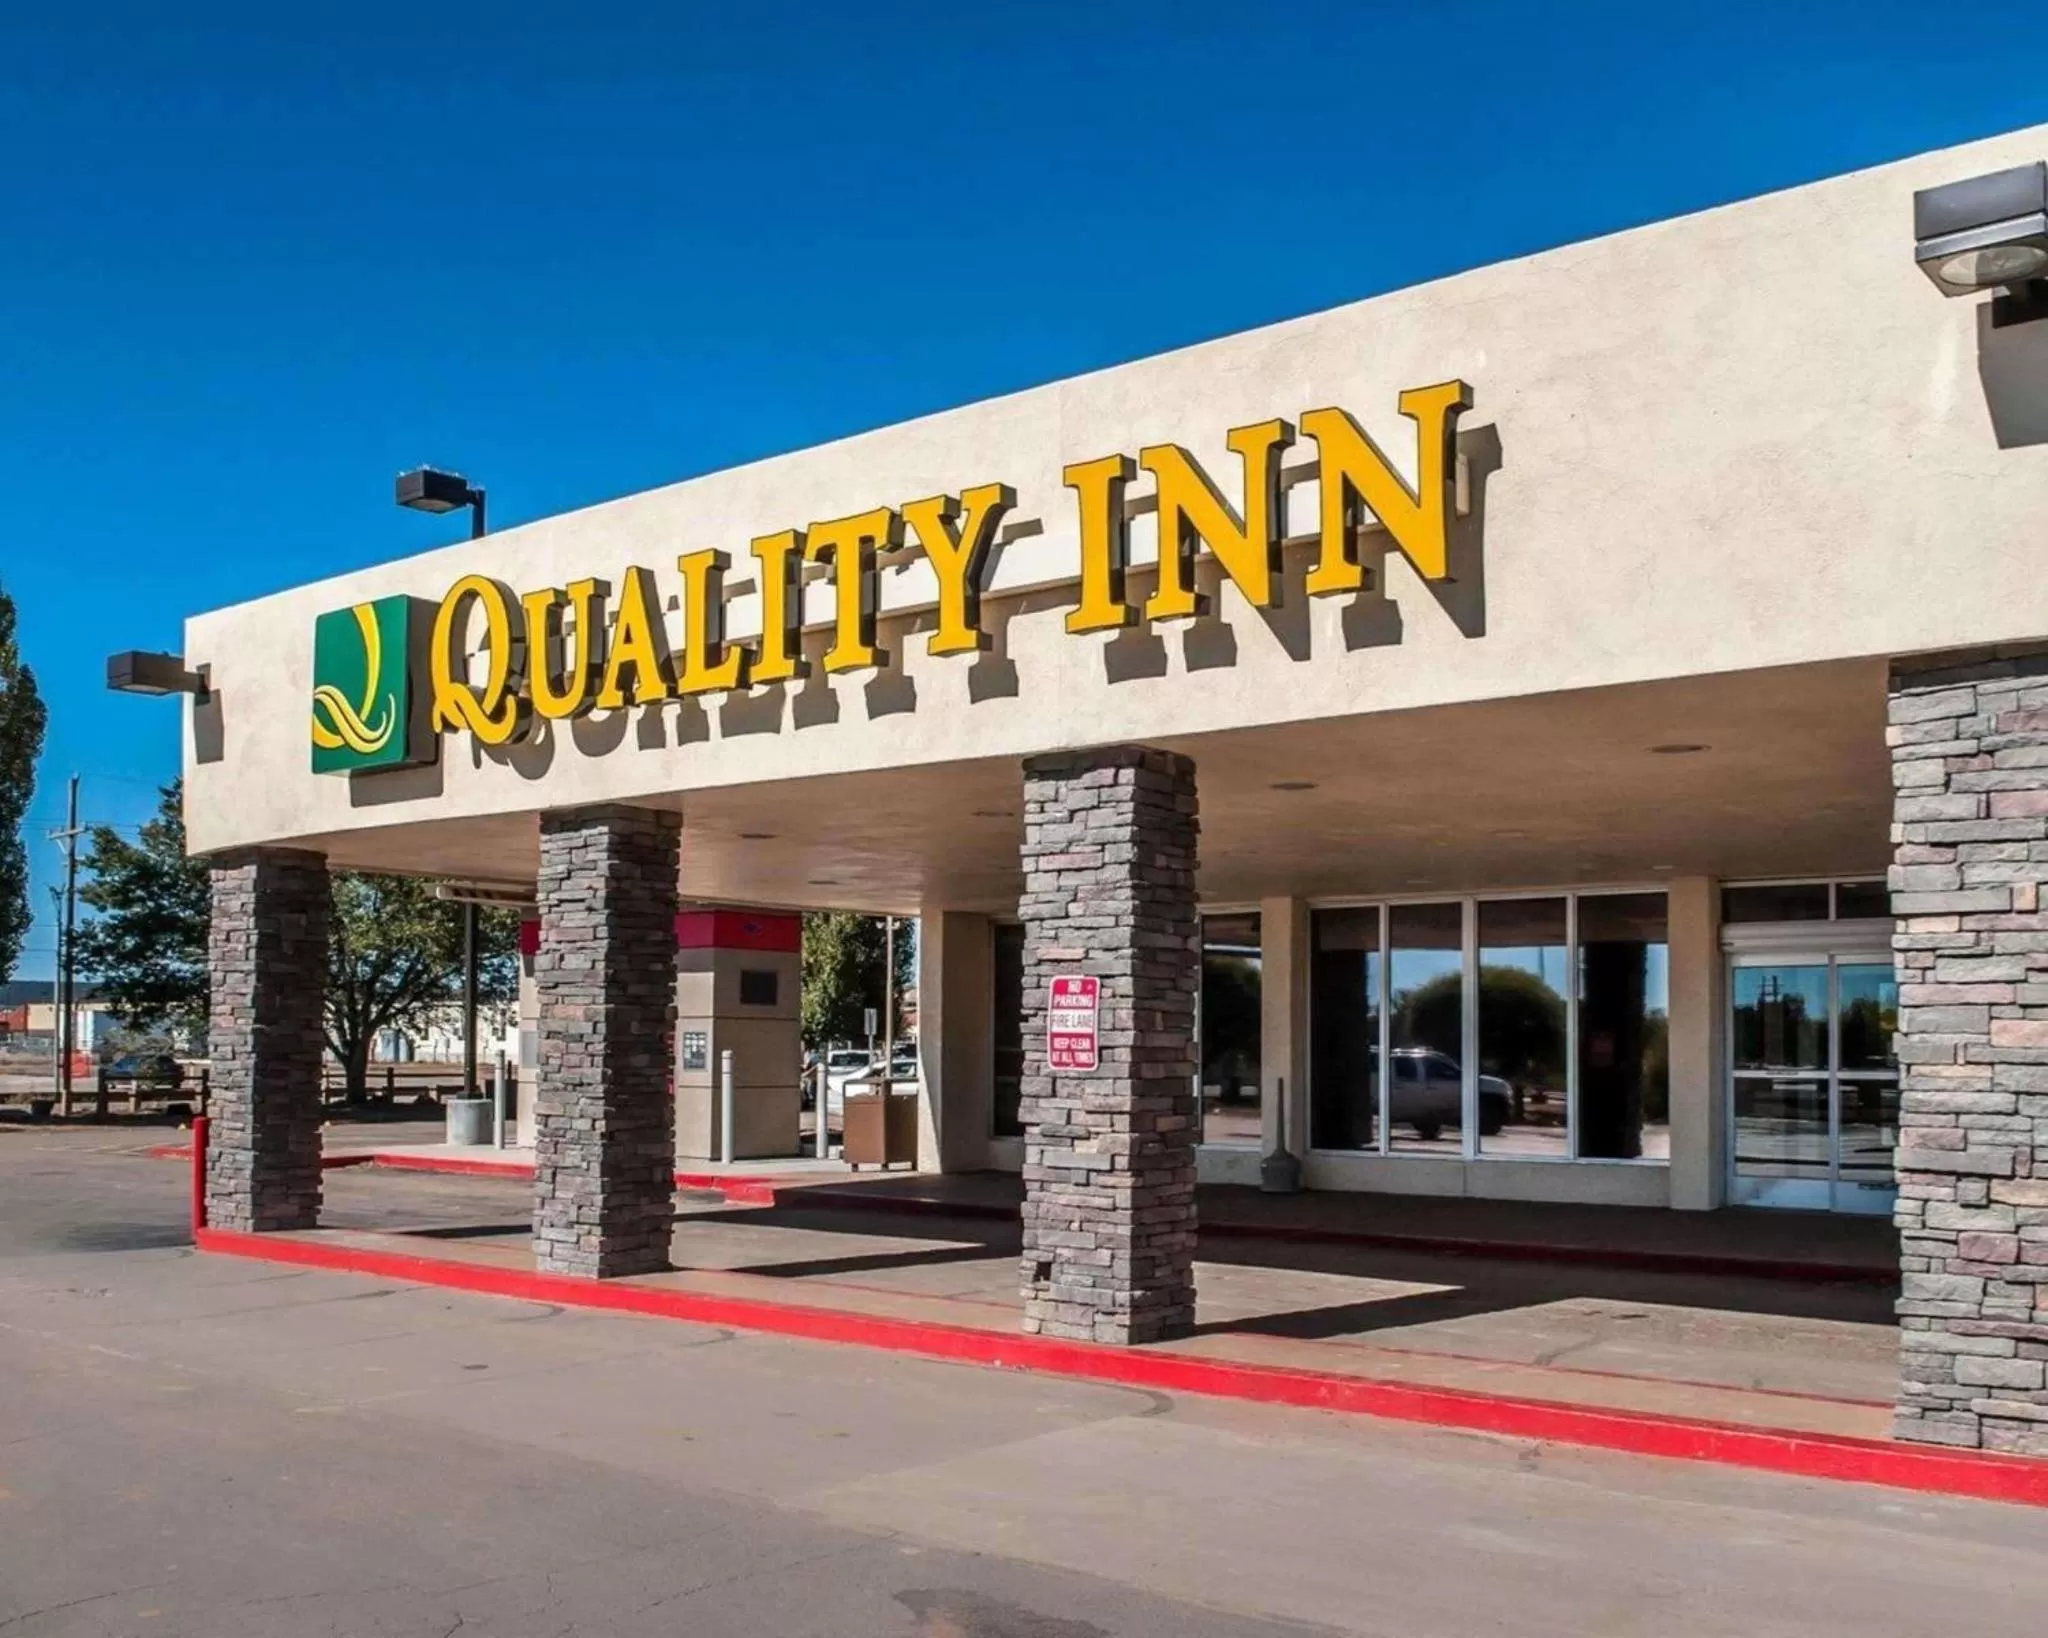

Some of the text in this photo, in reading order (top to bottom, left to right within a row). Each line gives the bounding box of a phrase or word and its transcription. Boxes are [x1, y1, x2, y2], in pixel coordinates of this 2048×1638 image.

[429, 380, 1474, 746] QUALITY INN
[1067, 980, 1082, 993] NO
[1053, 994, 1093, 1008] PARKING
[1051, 1013, 1093, 1028] FIRE LANE
[1053, 1038, 1091, 1050] KEEP CLEAR
